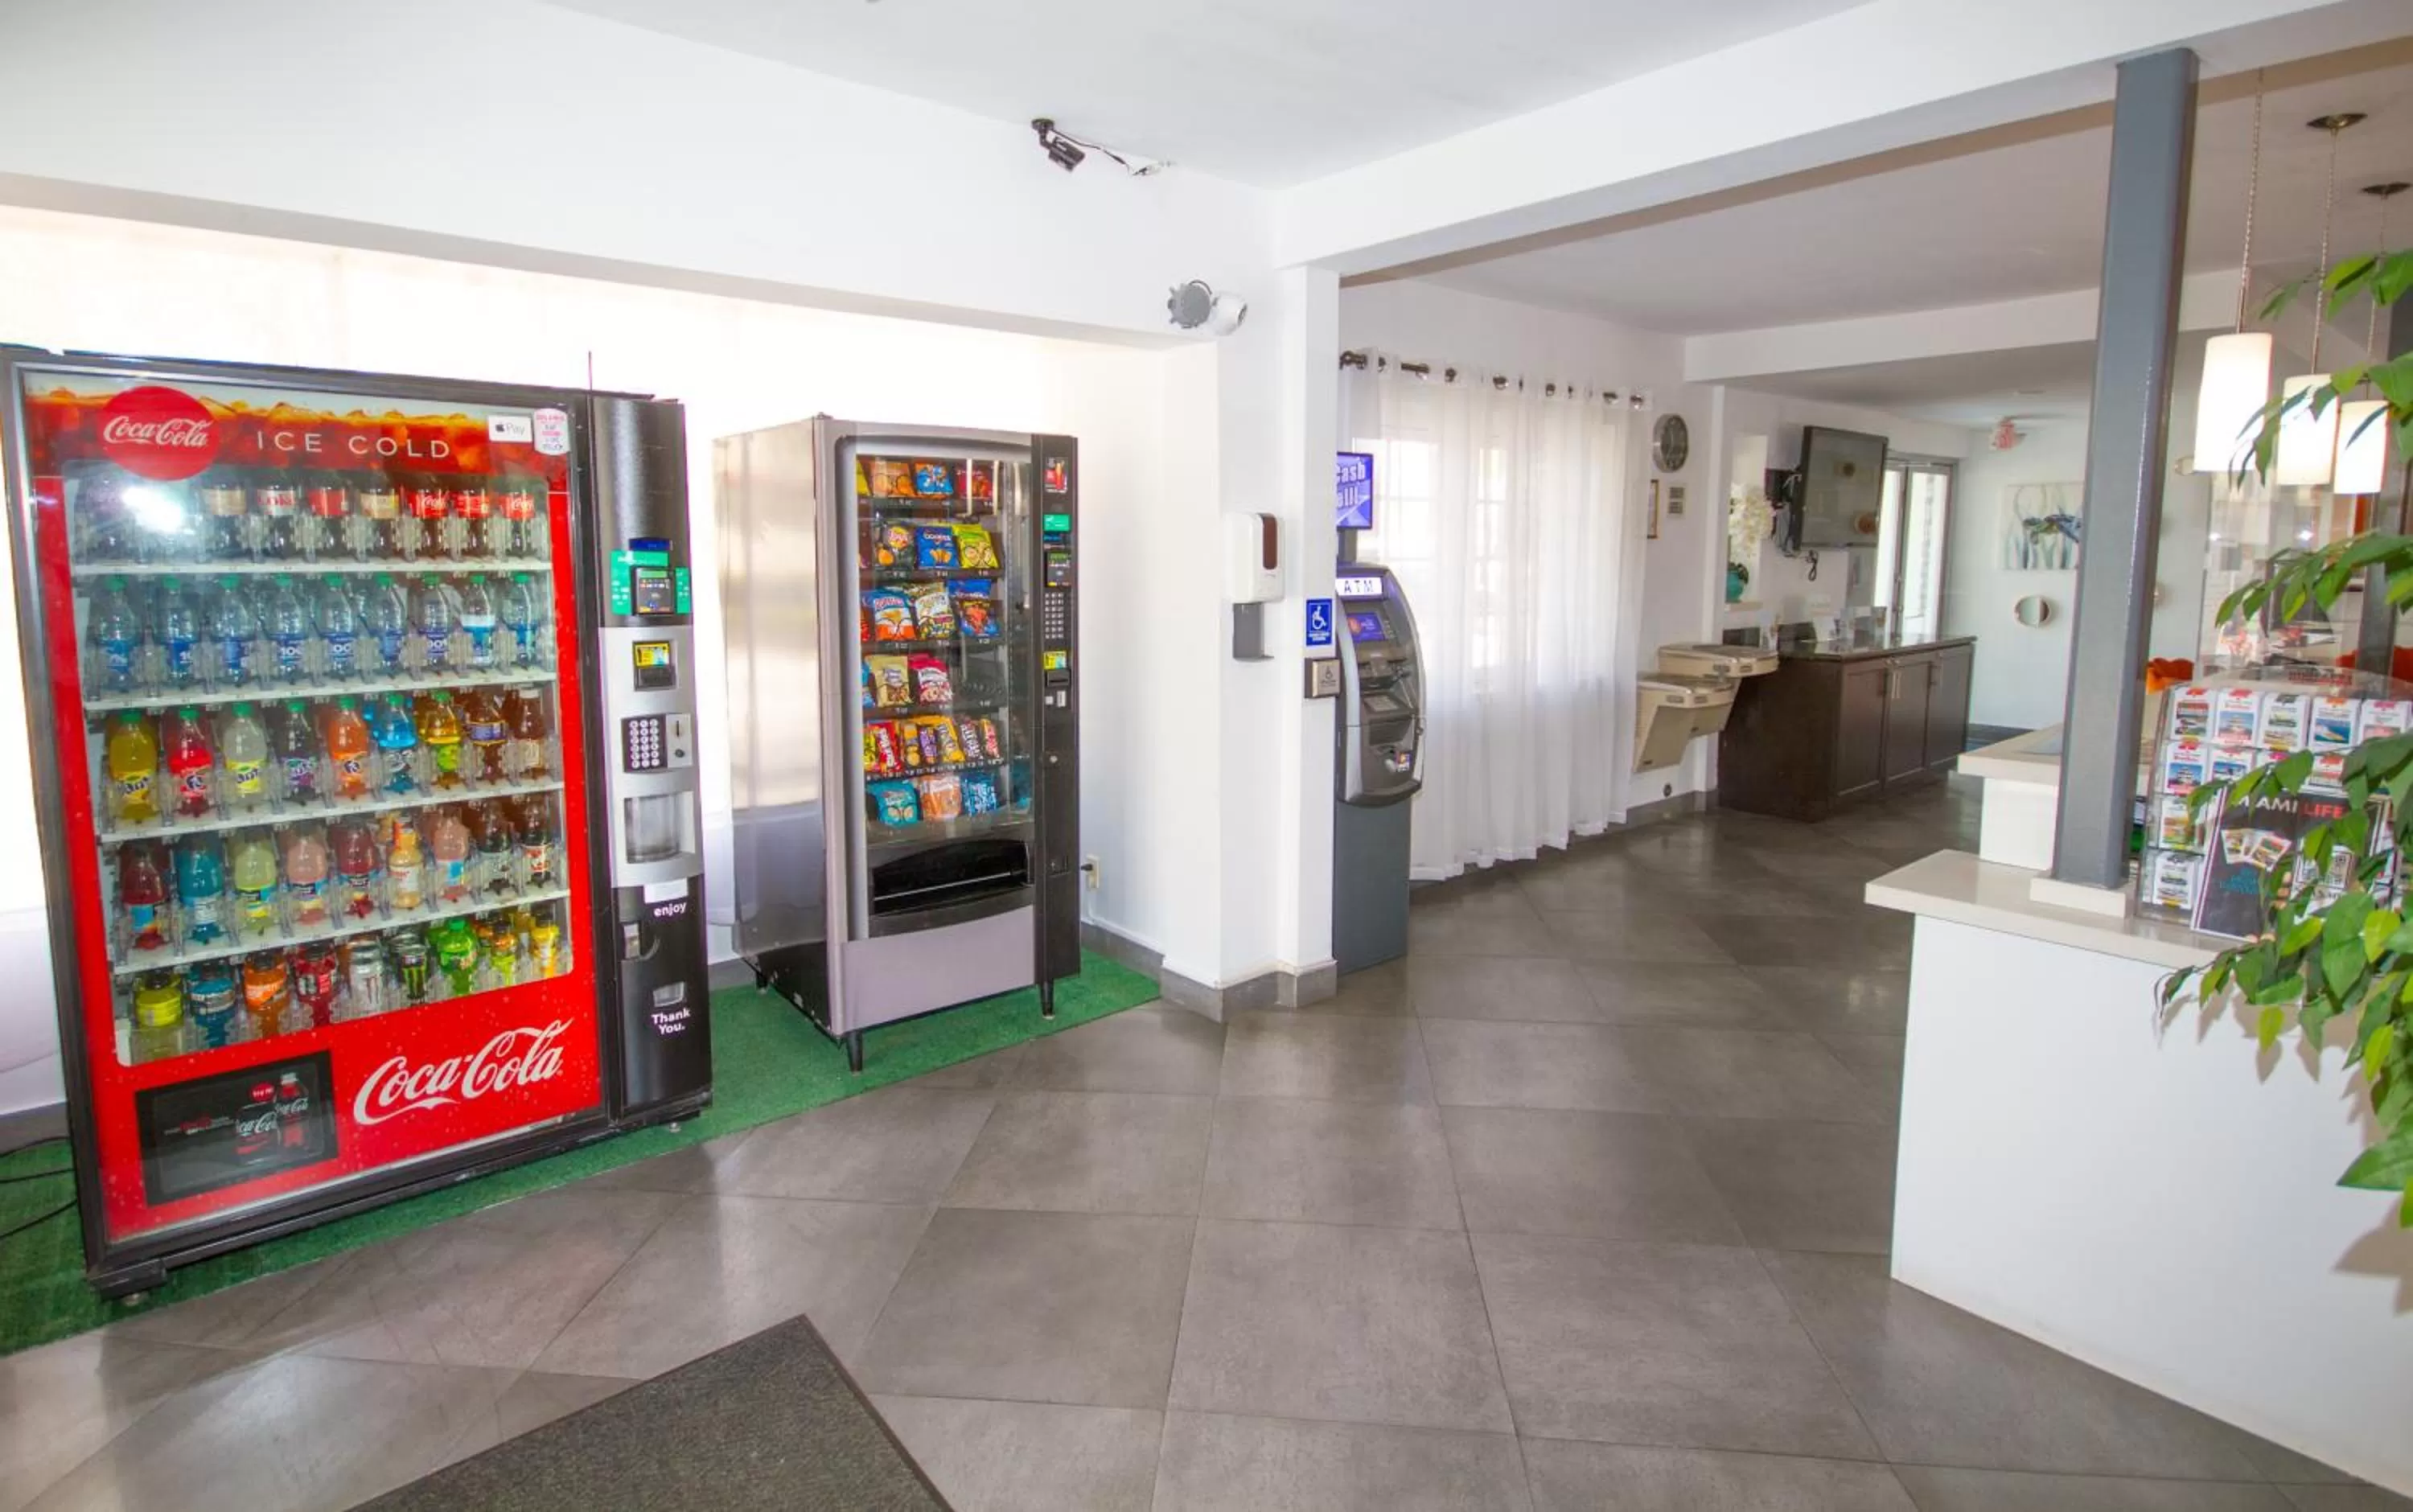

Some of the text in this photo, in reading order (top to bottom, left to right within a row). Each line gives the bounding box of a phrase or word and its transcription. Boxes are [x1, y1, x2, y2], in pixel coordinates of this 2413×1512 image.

[103, 415, 213, 448] Coca-Cola
[506, 422, 525, 435] Pay
[257, 432, 450, 459] ICE COLD
[1344, 579, 1374, 594] ATM
[2304, 803, 2344, 820] LIFE
[654, 901, 686, 918] enjoy
[651, 1007, 691, 1025] Thank
[658, 1023, 686, 1035] You.
[353, 1017, 575, 1126] Coca-Cola
